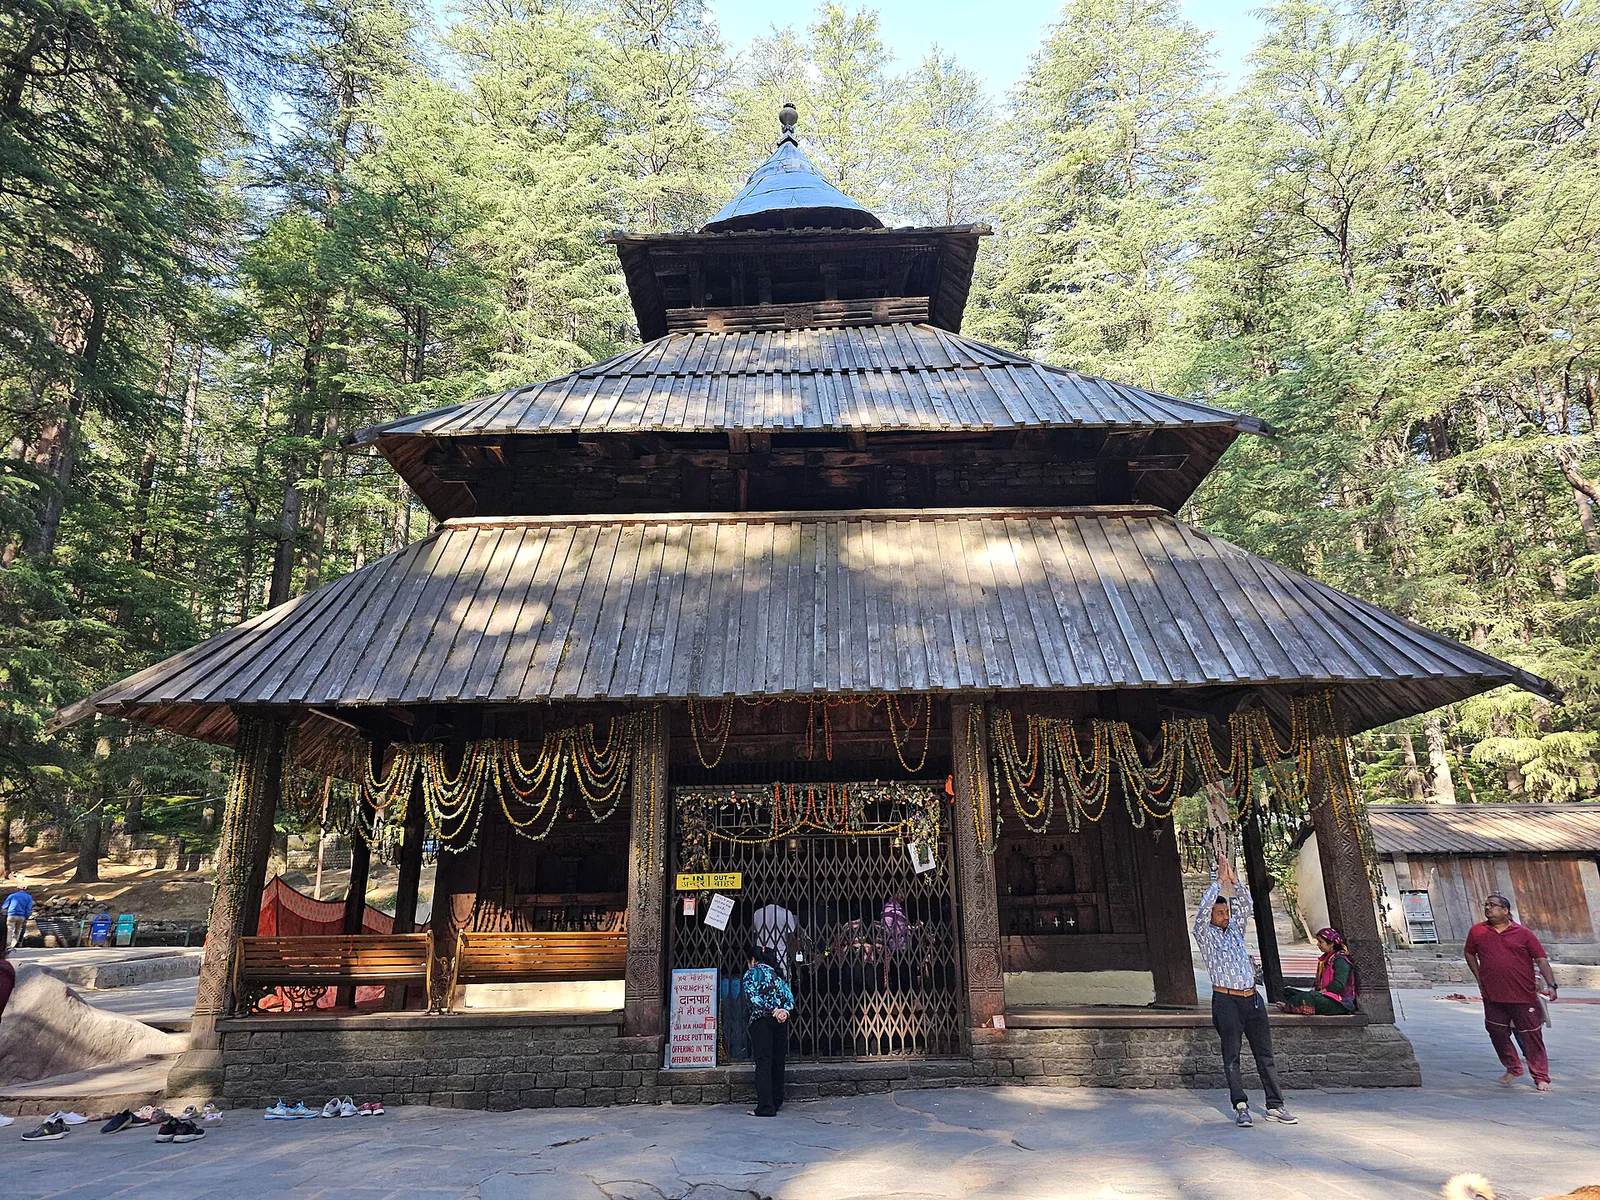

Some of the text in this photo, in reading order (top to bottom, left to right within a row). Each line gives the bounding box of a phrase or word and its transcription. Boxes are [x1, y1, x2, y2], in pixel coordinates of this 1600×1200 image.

[679, 995, 710, 1005] दानपात्र
[687, 1005, 695, 1015] ही
[673, 1033, 713, 1042] PLEASE PUT THE
[672, 1045, 694, 1053] OFFERING
[703, 1044, 714, 1052] THE
